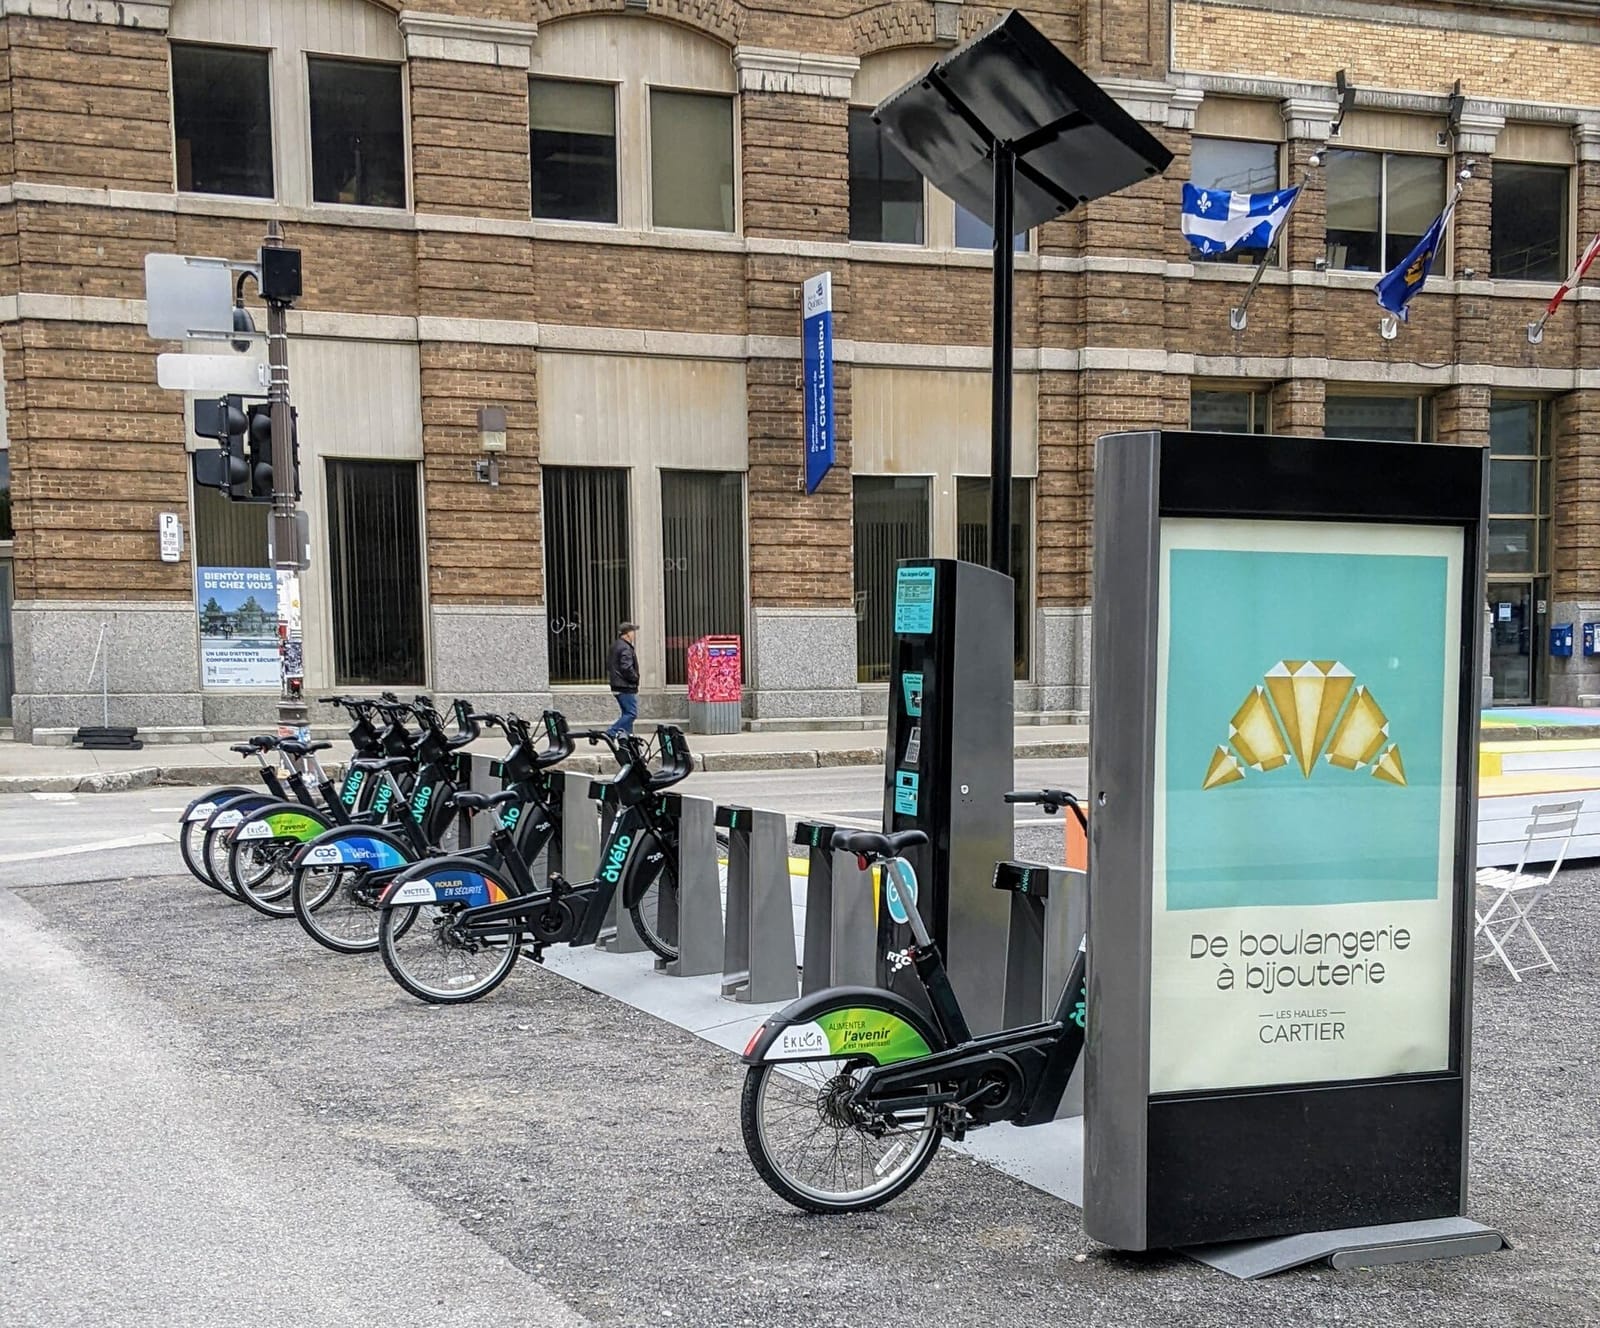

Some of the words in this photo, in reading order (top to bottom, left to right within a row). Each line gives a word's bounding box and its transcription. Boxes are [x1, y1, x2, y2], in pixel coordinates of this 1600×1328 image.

[818, 320, 826, 427] Cité-Limoilou
[819, 431, 827, 450] La
[166, 515, 174, 529] P
[204, 571, 245, 581] BIENTÔT
[246, 572, 272, 581] PRÈS
[204, 581, 218, 589] DE
[219, 581, 245, 589] CHEZ
[246, 582, 274, 590] VOUS
[342, 770, 364, 805] àVélo
[314, 848, 337, 858] GDG
[601, 835, 632, 883] àVélo
[435, 880, 463, 888] ROULER
[444, 888, 454, 896] EN
[454, 885, 483, 896] SÉCURITÉ
[1190, 933, 1228, 959] De
[1240, 925, 1411, 959] boulangerie
[886, 951, 912, 967] RTC
[1216, 962, 1234, 990] à
[1246, 958, 1386, 994] bijouterie
[1276, 1010, 1292, 1020] LES
[1293, 1008, 1328, 1019] HALLES
[828, 1020, 866, 1031] ALIMENTER
[1259, 1022, 1346, 1044] CARTIER
[843, 1027, 891, 1042] l'avenir
